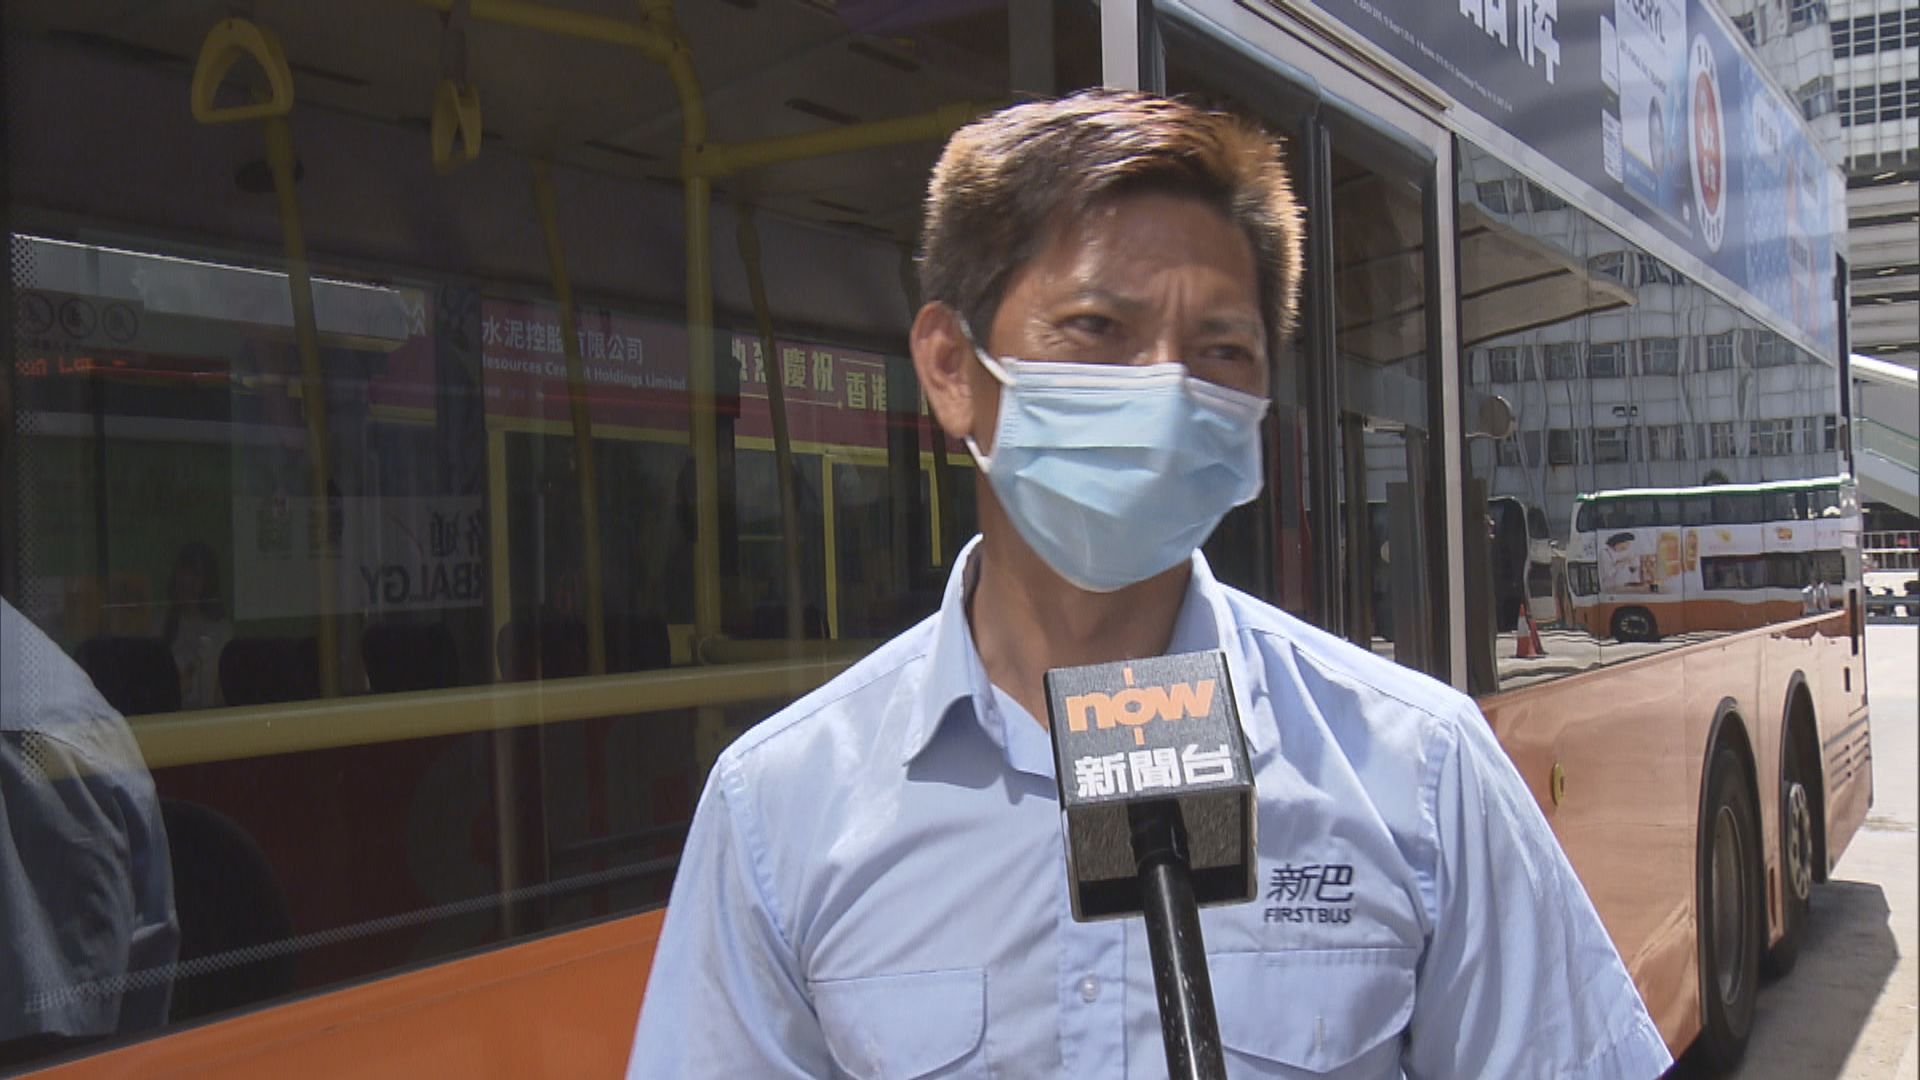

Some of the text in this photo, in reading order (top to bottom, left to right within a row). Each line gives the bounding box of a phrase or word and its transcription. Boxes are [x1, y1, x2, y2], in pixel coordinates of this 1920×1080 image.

[1065, 678, 1216, 733] now
[1074, 742, 1235, 798] 新聞台
[1266, 864, 1355, 903] 新巴
